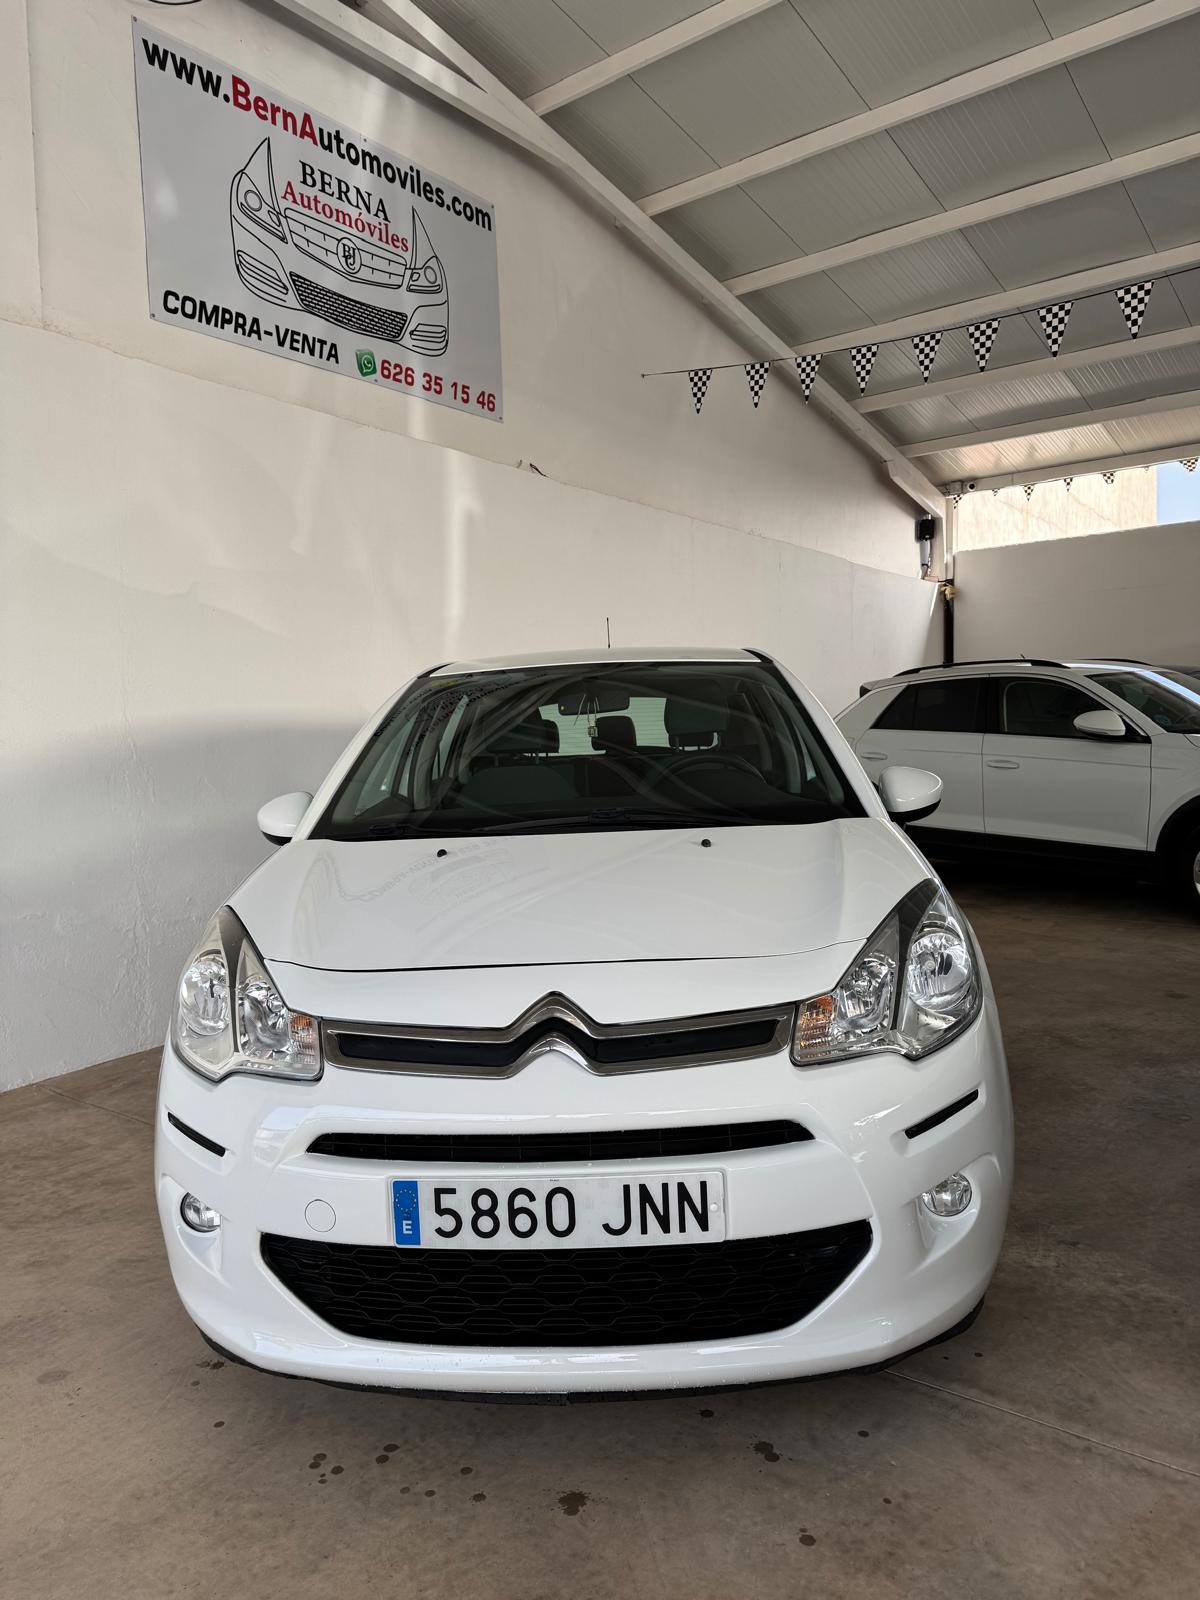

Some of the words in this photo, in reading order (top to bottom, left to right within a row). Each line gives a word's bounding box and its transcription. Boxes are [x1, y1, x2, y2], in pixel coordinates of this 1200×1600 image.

[142, 37, 492, 231] www.BernAutomoviles.com
[281, 181, 409, 252] Automóviles
[299, 160, 391, 223] BERNA
[163, 290, 339, 364] COMPRA-VENTA
[380, 360, 415, 387] 626
[422, 372, 443, 395] 35
[451, 381, 470, 404] 15
[477, 391, 496, 412] 46
[403, 1220, 413, 1234] E
[433, 1186, 576, 1239] 5860
[602, 1180, 709, 1236] JNN
